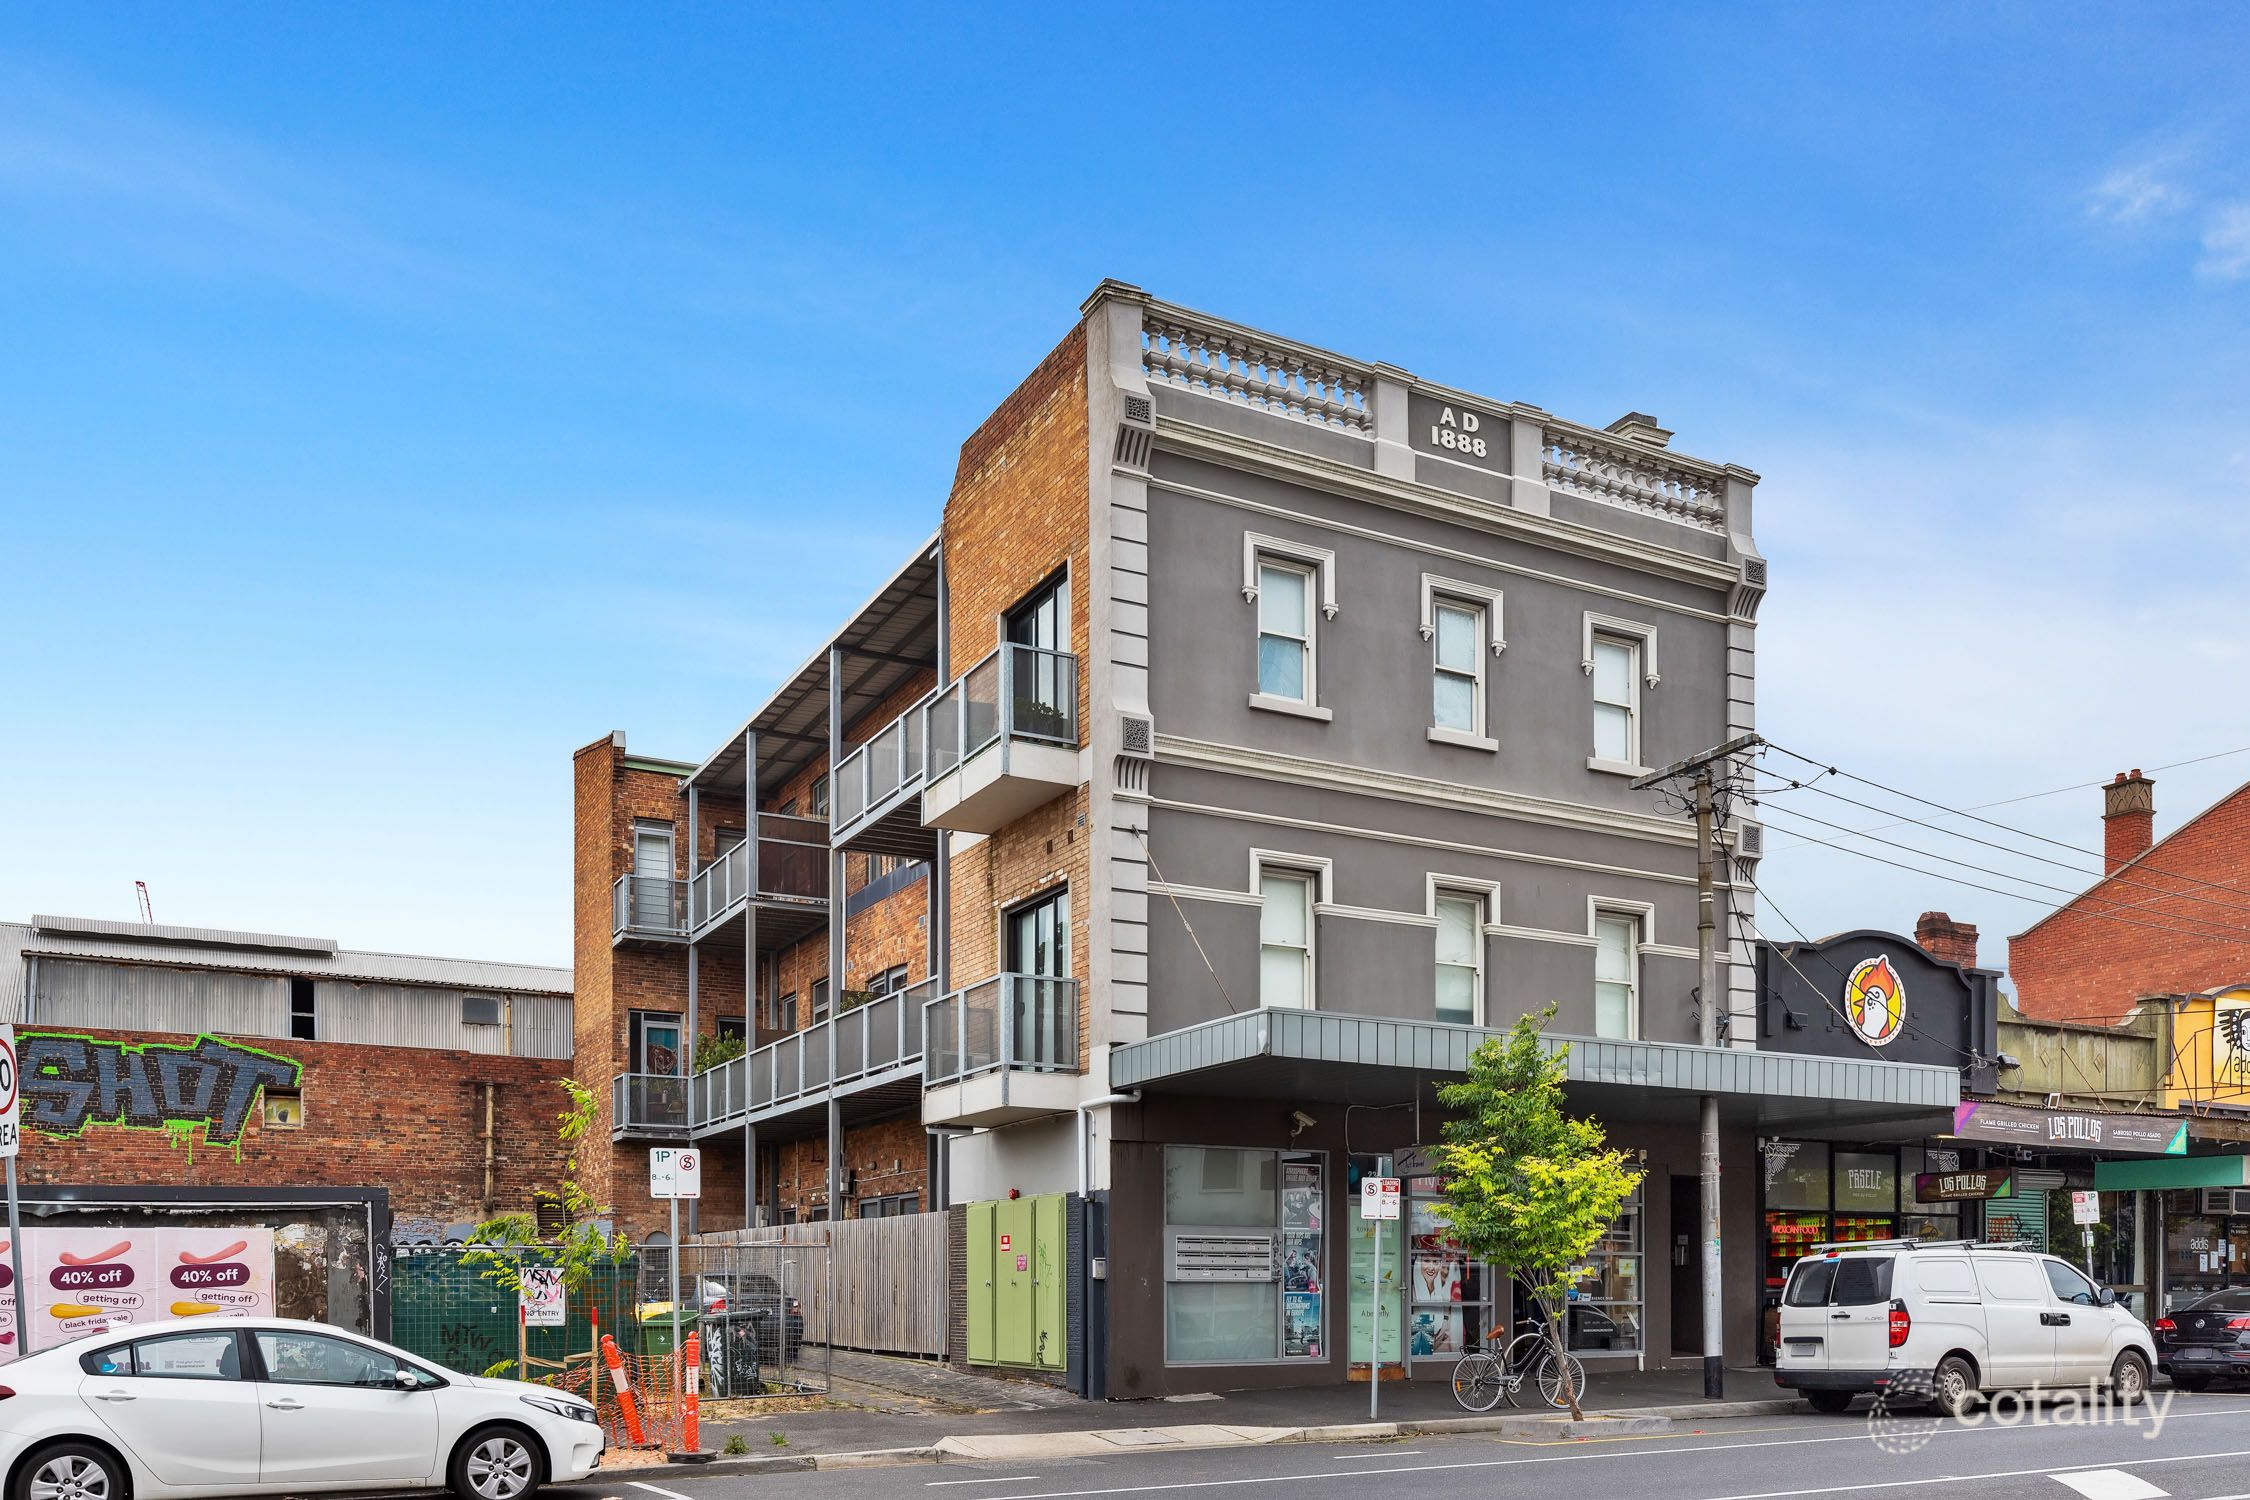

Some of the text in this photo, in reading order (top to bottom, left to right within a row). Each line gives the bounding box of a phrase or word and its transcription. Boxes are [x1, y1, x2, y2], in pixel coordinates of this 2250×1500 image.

[1440, 407, 1480, 433] A D
[1431, 426, 1487, 458] 1888
[2048, 1116, 2101, 1143] LOS POLLOS
[655, 1150, 670, 1163] 1P
[1939, 1174, 1987, 1193] LOS POLLOS
[2088, 1193, 2095, 1201] 1P
[2190, 1237, 2208, 1250] addis
[61, 1269, 122, 1284] 40% off
[180, 1268, 239, 1283] 40% off
[1, 1298, 16, 1306] off
[83, 1294, 137, 1305] getting off
[201, 1293, 253, 1303] getting off
[537, 1310, 559, 1318] ENTRY
[65, 1320, 86, 1330] black
